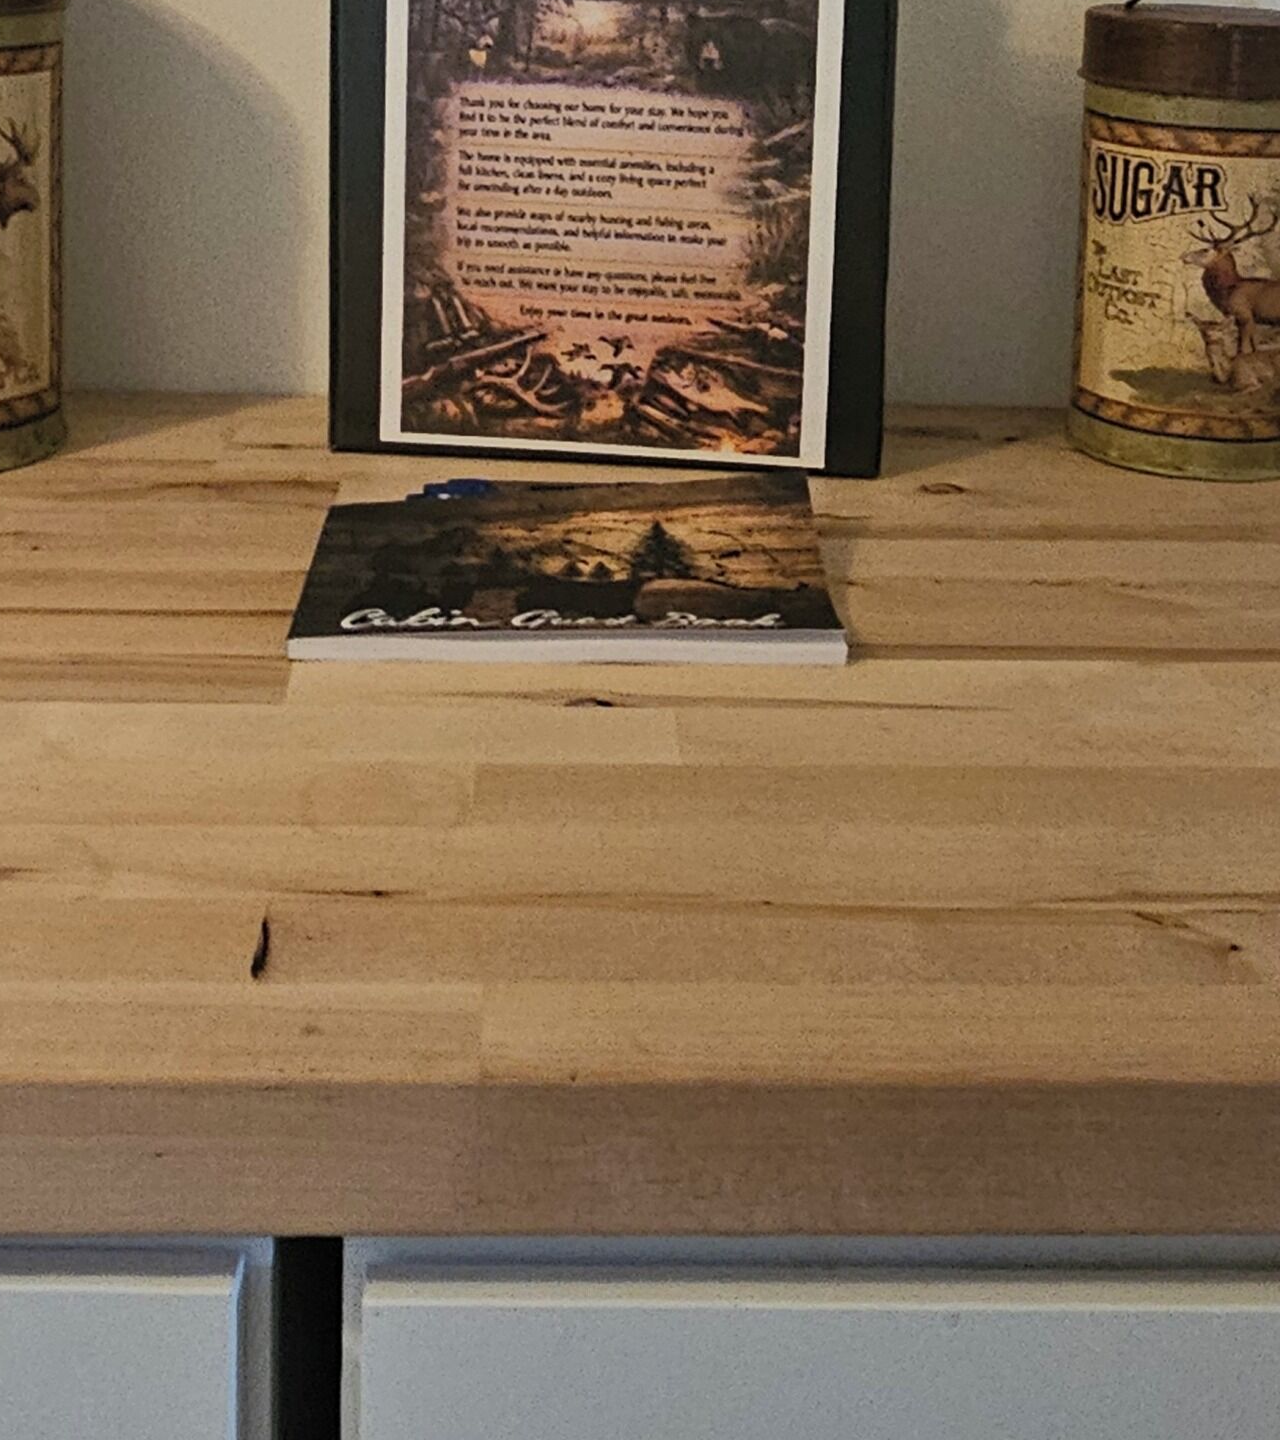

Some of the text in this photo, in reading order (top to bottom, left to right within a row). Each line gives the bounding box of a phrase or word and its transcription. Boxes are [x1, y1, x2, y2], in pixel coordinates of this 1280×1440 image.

[460, 97, 485, 108] Thank
[489, 100, 504, 110] you
[508, 98, 519, 108] for
[523, 99, 561, 113] choosing
[564, 103, 579, 111] our
[582, 102, 605, 113] home
[609, 103, 621, 114] for
[624, 107, 644, 117] your
[671, 108, 684, 117] We
[687, 108, 708, 120] hope
[712, 111, 729, 121] you
[459, 111, 744, 137] find it to be the perfect blend of comfort and convenience during
[459, 129, 477, 138] your
[481, 129, 500, 137] time
[504, 128, 512, 138] in
[515, 128, 528, 139] the
[459, 150, 715, 176] The home is equipped with essential amenities, including a
[458, 164, 472, 175] full
[475, 166, 510, 178] kitchen,
[513, 169, 535, 179] clean
[569, 171, 585, 181] and
[588, 174, 593, 182] a
[596, 175, 616, 186] cozy
[619, 173, 643, 188] living
[647, 177, 672, 188] space
[674, 178, 706, 190] perfect
[458, 179, 470, 190] for
[473, 182, 519, 196] unwinding
[523, 184, 543, 194] after
[546, 186, 551, 194] a
[553, 185, 569, 197] day
[1093, 153, 1222, 221] SUGAR
[457, 206, 471, 217] We
[475, 207, 492, 217] also
[494, 208, 526, 220] provide
[530, 212, 553, 223] maps
[555, 211, 564, 221] of
[567, 212, 597, 227] nearby
[600, 214, 632, 228] hunting
[635, 215, 652, 226] and
[655, 216, 683, 231] fishing
[457, 220, 477, 231] local
[563, 226, 579, 237] and
[582, 227, 611, 240] helpful
[614, 230, 665, 242] information
[667, 234, 676, 242] to
[679, 234, 703, 245] make
[707, 236, 726, 248] your
[457, 236, 472, 248] trip
[487, 238, 519, 249] smooth
[523, 242, 532, 250] as
[457, 261, 463, 271] If
[466, 263, 481, 273] you
[484, 263, 505, 274] need
[507, 265, 550, 275] assistance
[553, 268, 561, 276] or
[564, 266, 584, 277] have
[586, 271, 601, 281] any
[651, 272, 677, 284] please
[680, 272, 697, 283] feel
[699, 273, 716, 284] free
[462, 277, 470, 286] to
[473, 277, 496, 288] reach
[518, 278, 533, 289] We
[536, 281, 557, 290] want
[559, 283, 578, 294] your
[582, 283, 599, 296] stay
[602, 286, 611, 294] to
[614, 284, 625, 295] be
[519, 304, 543, 320] Enjoy
[547, 308, 567, 320] your
[570, 308, 591, 318] time
[594, 308, 604, 319] in
[607, 310, 622, 320] the
[625, 312, 648, 323] great
[339, 607, 784, 630] Cabin Guest Book
